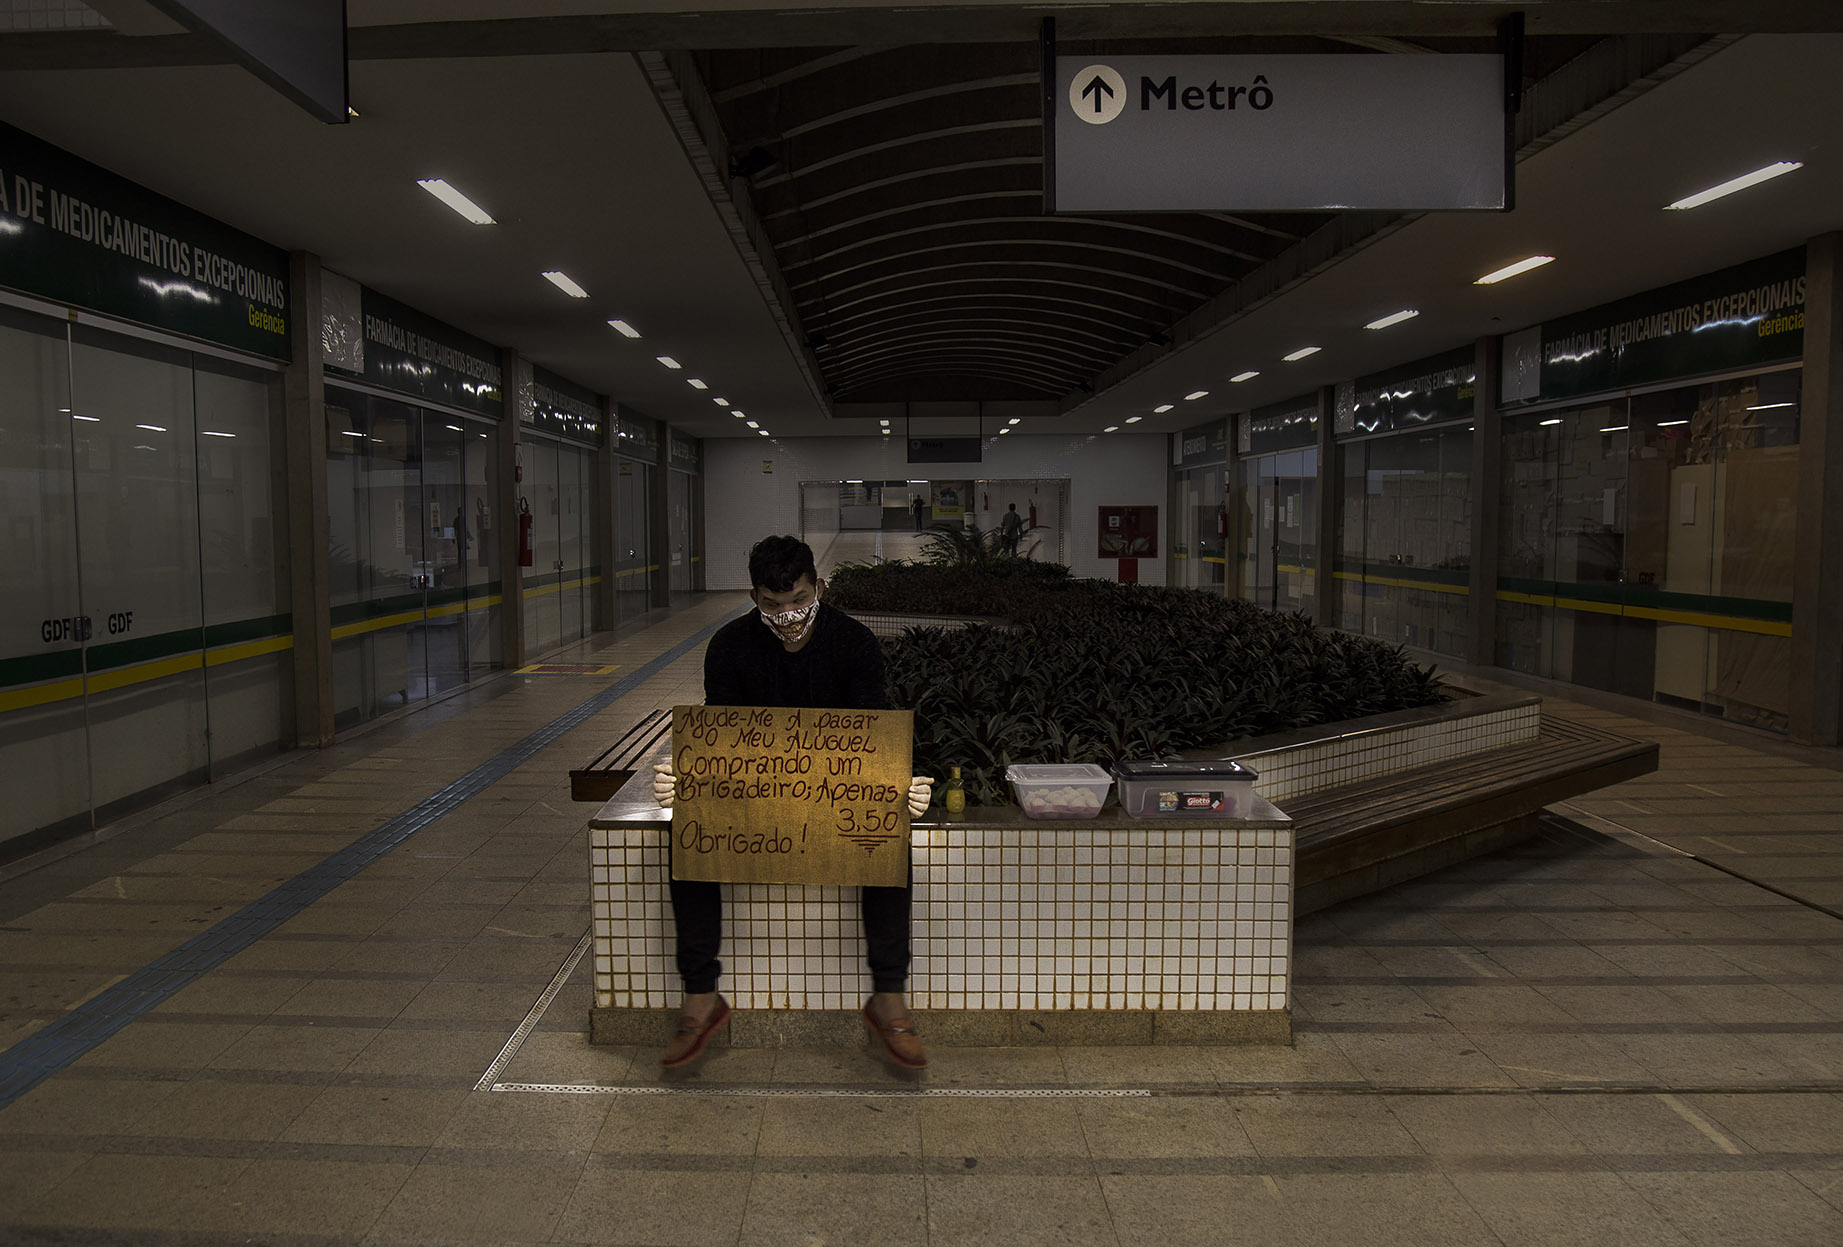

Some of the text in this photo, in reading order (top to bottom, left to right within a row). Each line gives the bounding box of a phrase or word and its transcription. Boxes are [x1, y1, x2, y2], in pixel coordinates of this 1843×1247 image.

[1141, 75, 1274, 111] Metrô
[15, 174, 46, 225] DE
[50, 187, 191, 277] MEDICAMENTOS
[193, 246, 285, 310] EXCEPCIONAIS
[248, 303, 285, 336] Gerência
[366, 312, 406, 353] FARMÁCIA
[407, 330, 417, 356] DE
[1544, 275, 1806, 364] FARMÁCIA DE MEDICAMENTOS EXCEPCIONAIS
[1758, 308, 1805, 337] Gerência
[42, 618, 71, 642] GDF
[108, 611, 133, 635] GDF
[677, 745, 862, 780] Comprando um
[815, 777, 898, 808] Apenas
[1187, 797, 1211, 806] Giotto
[836, 808, 899, 832] 3,50
